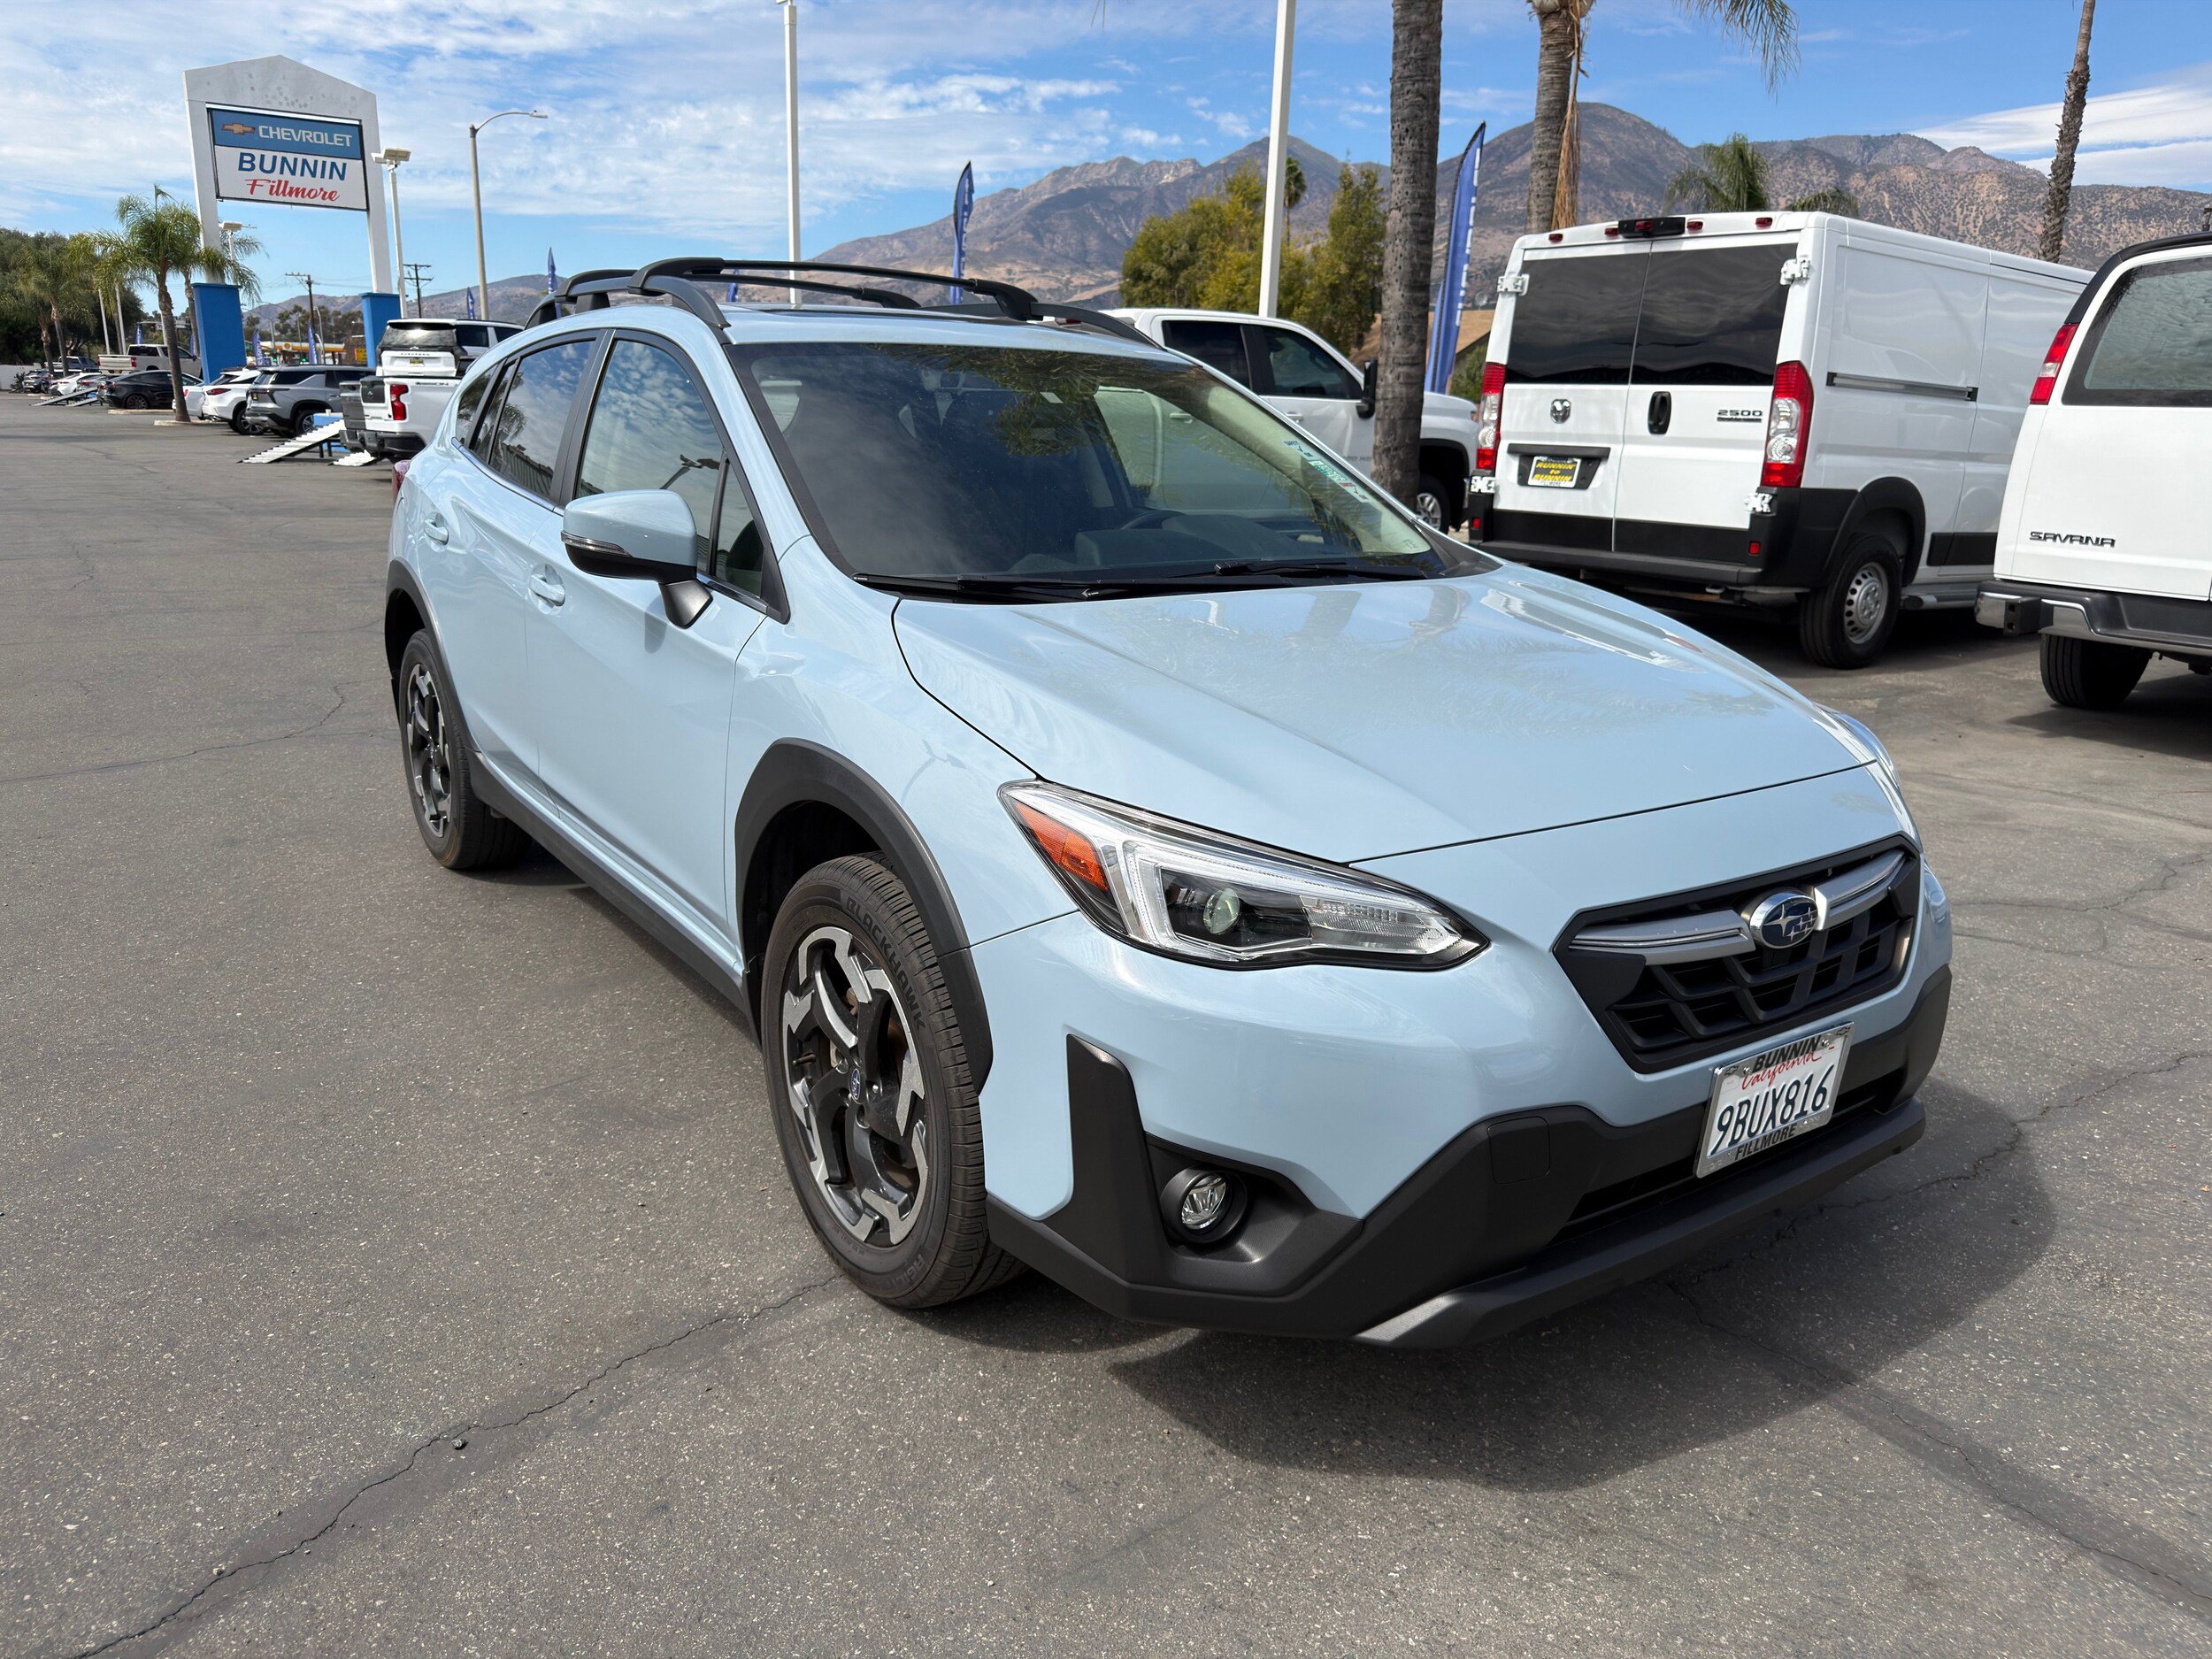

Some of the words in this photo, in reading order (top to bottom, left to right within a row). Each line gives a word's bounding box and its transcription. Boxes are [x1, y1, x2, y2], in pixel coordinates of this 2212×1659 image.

[258, 125, 352, 147] CHEVROLET
[238, 152, 347, 181] BUNNIN
[244, 179, 340, 202] Fillmore
[2029, 531, 2116, 549] SAVANA
[846, 896, 926, 1033] BLACKHAWK
[1741, 1049, 1823, 1090] California
[1751, 1034, 1823, 1073] BUNNIN
[1709, 1064, 1835, 1156] 9BUX816
[1734, 1123, 1799, 1160] FILLMORE
